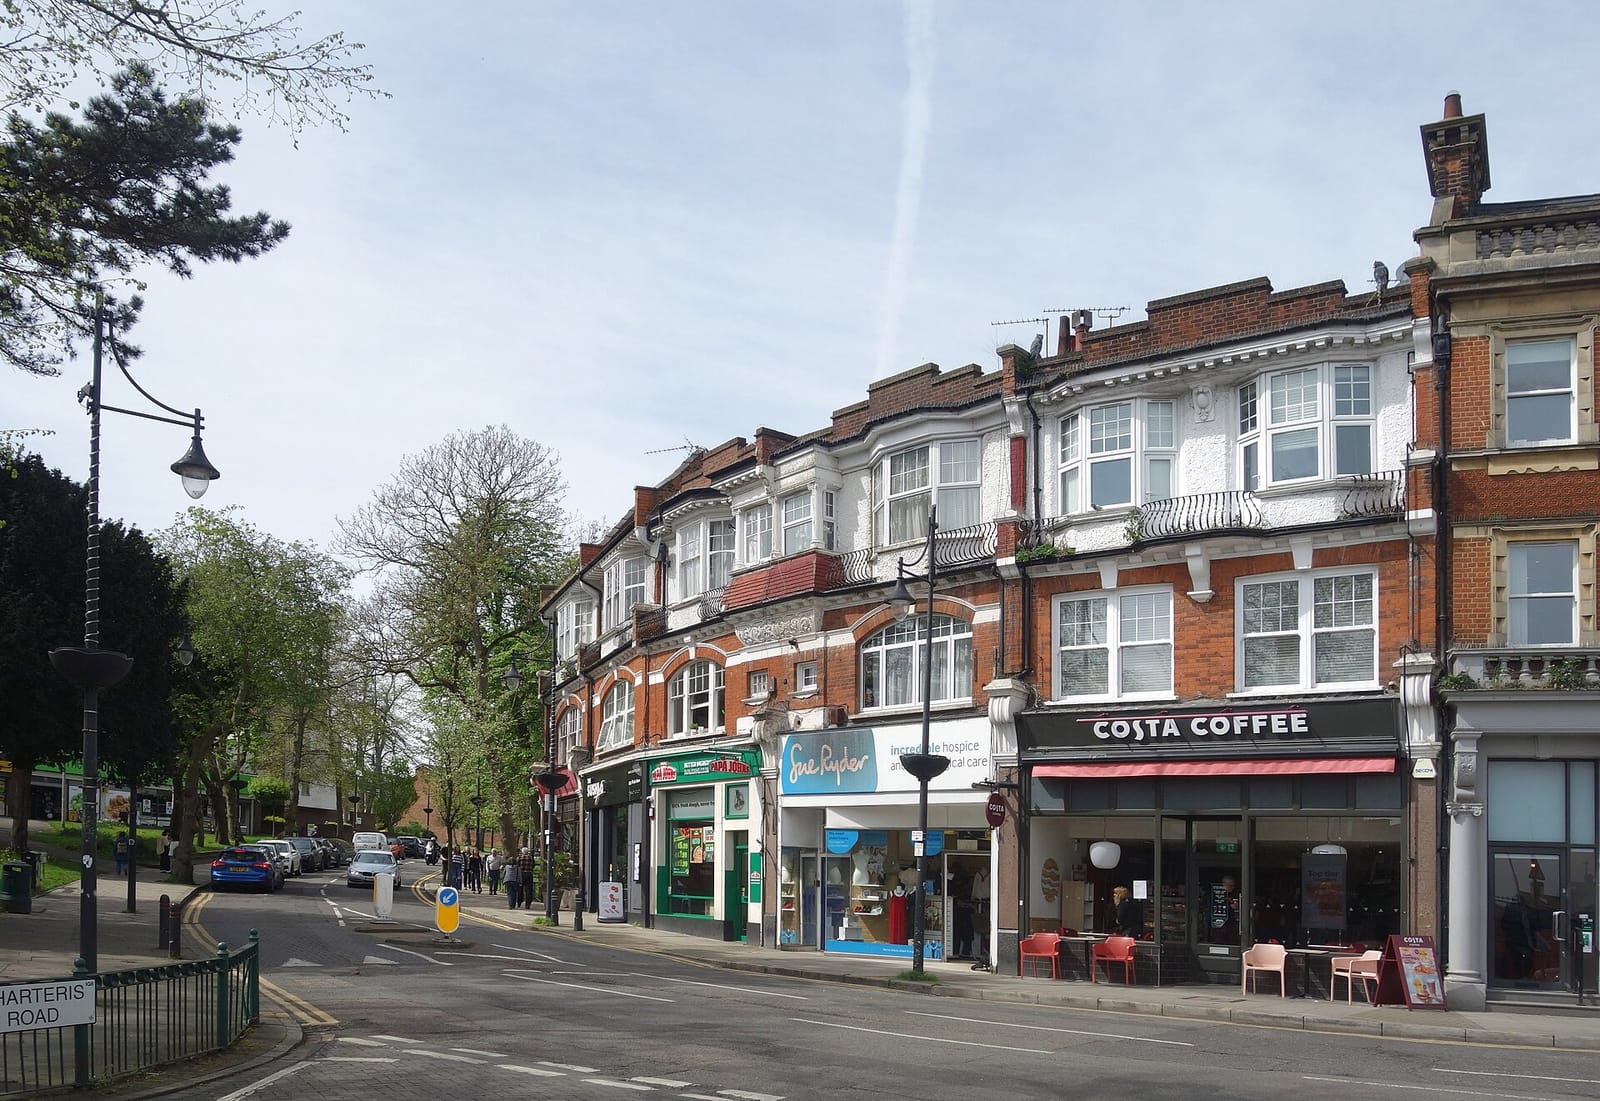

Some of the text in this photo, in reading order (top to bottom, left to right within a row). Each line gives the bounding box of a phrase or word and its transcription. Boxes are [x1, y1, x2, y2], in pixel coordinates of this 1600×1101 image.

[1093, 713, 1309, 741] COSTA COFFEE
[942, 740, 980, 754] hospice
[789, 743, 869, 786] Sue Ryder
[966, 757, 988, 767] care
[989, 803, 1004, 812] COSTA
[1403, 936, 1424, 944] COSTA
[8, 1007, 60, 1027] ROAD
